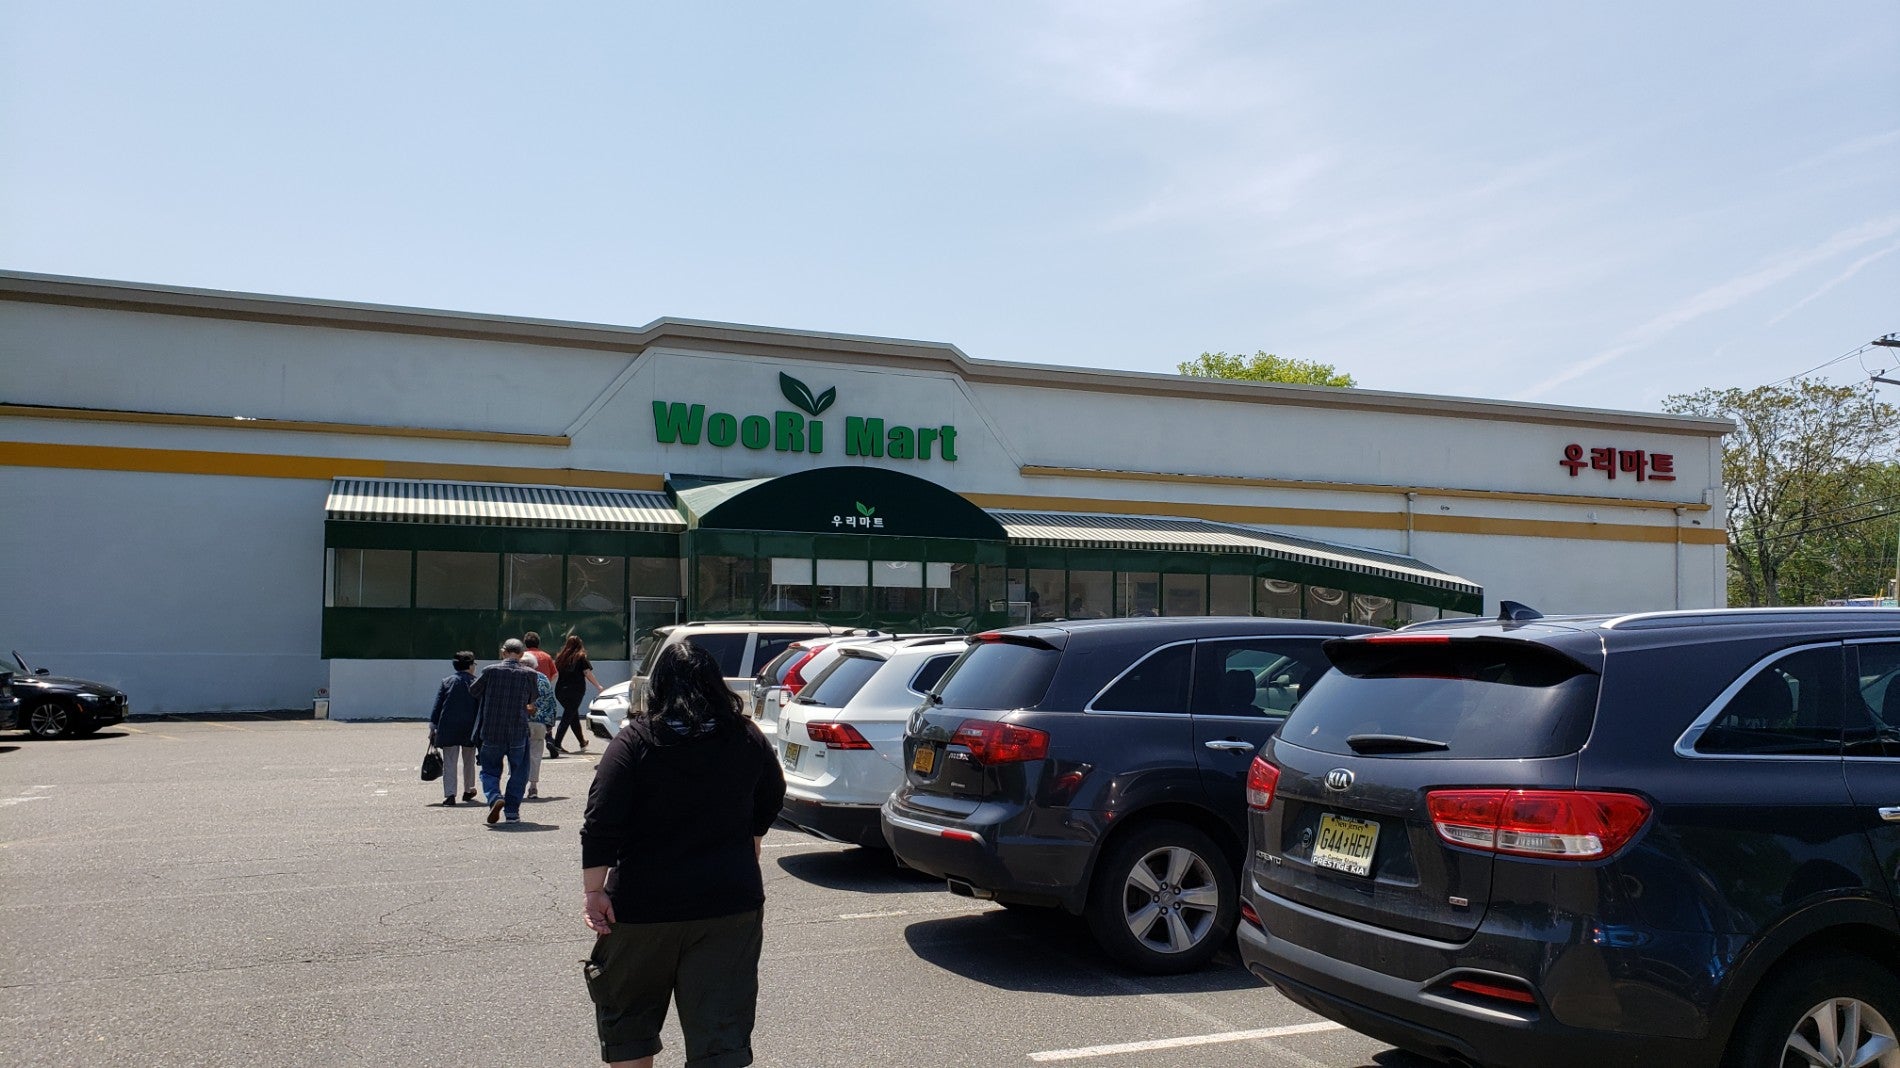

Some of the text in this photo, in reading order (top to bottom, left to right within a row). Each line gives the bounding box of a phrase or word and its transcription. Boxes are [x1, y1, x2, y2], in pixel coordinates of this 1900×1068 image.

[845, 416, 959, 462] Mart
[1559, 443, 1677, 482] 우리마트
[831, 515, 884, 529] 우리마트
[1312, 856, 1350, 872] PRESTIGE
[1350, 863, 1365, 875] KIA
